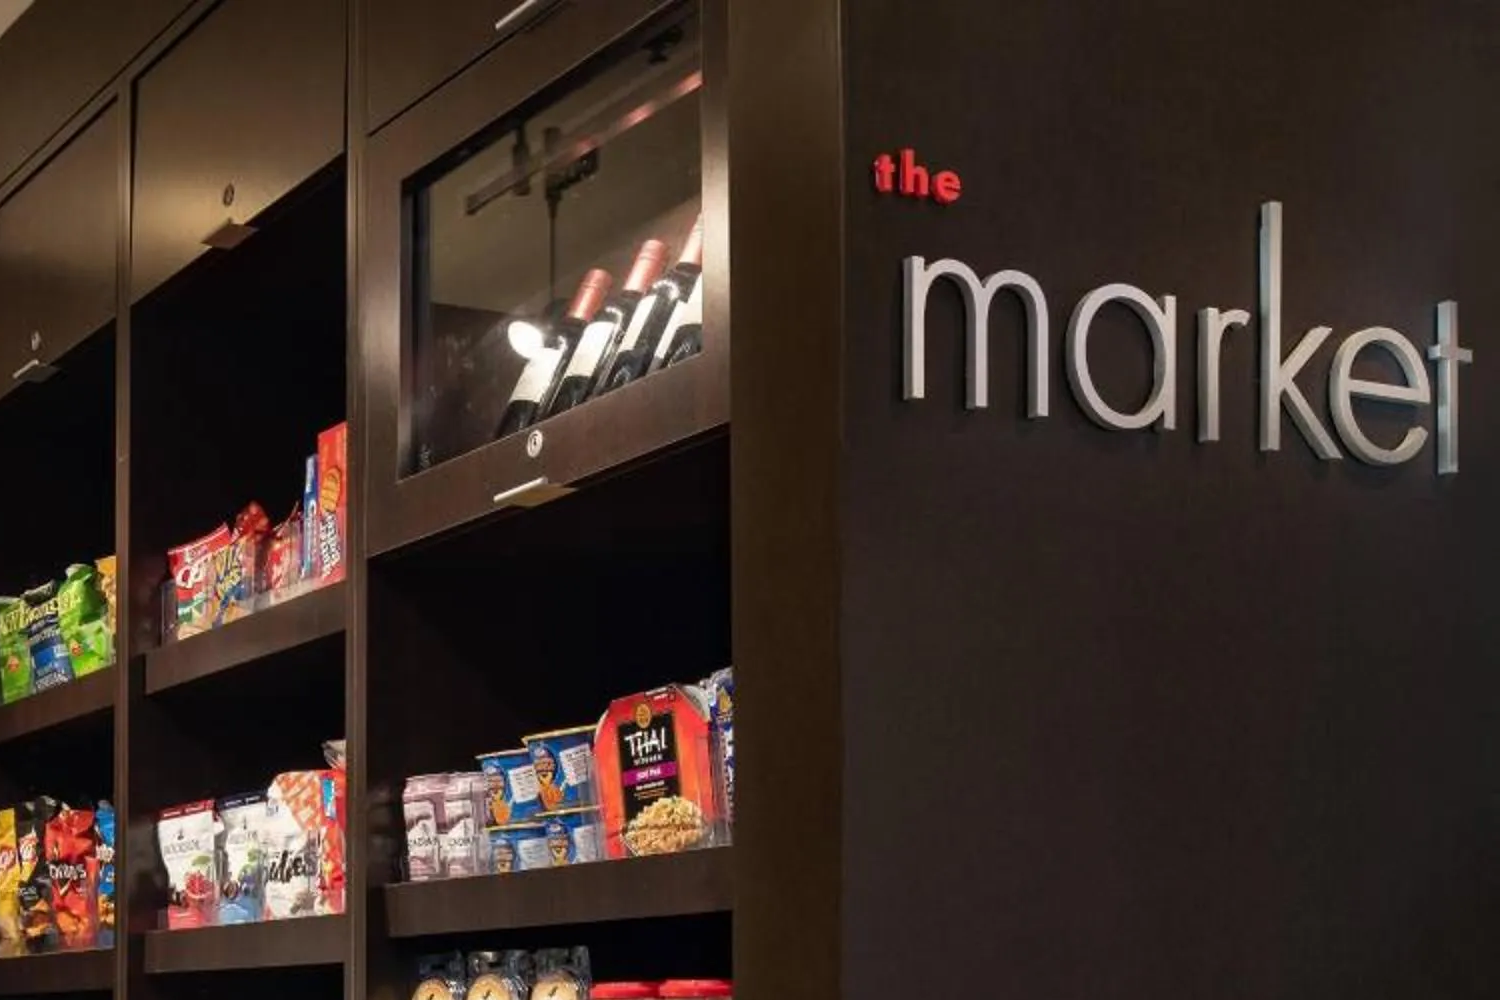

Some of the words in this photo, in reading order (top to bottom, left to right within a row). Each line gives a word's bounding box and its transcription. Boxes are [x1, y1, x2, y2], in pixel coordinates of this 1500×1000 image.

[873, 149, 963, 202] the
[902, 200, 1474, 475] market
[624, 726, 668, 757] THAI
